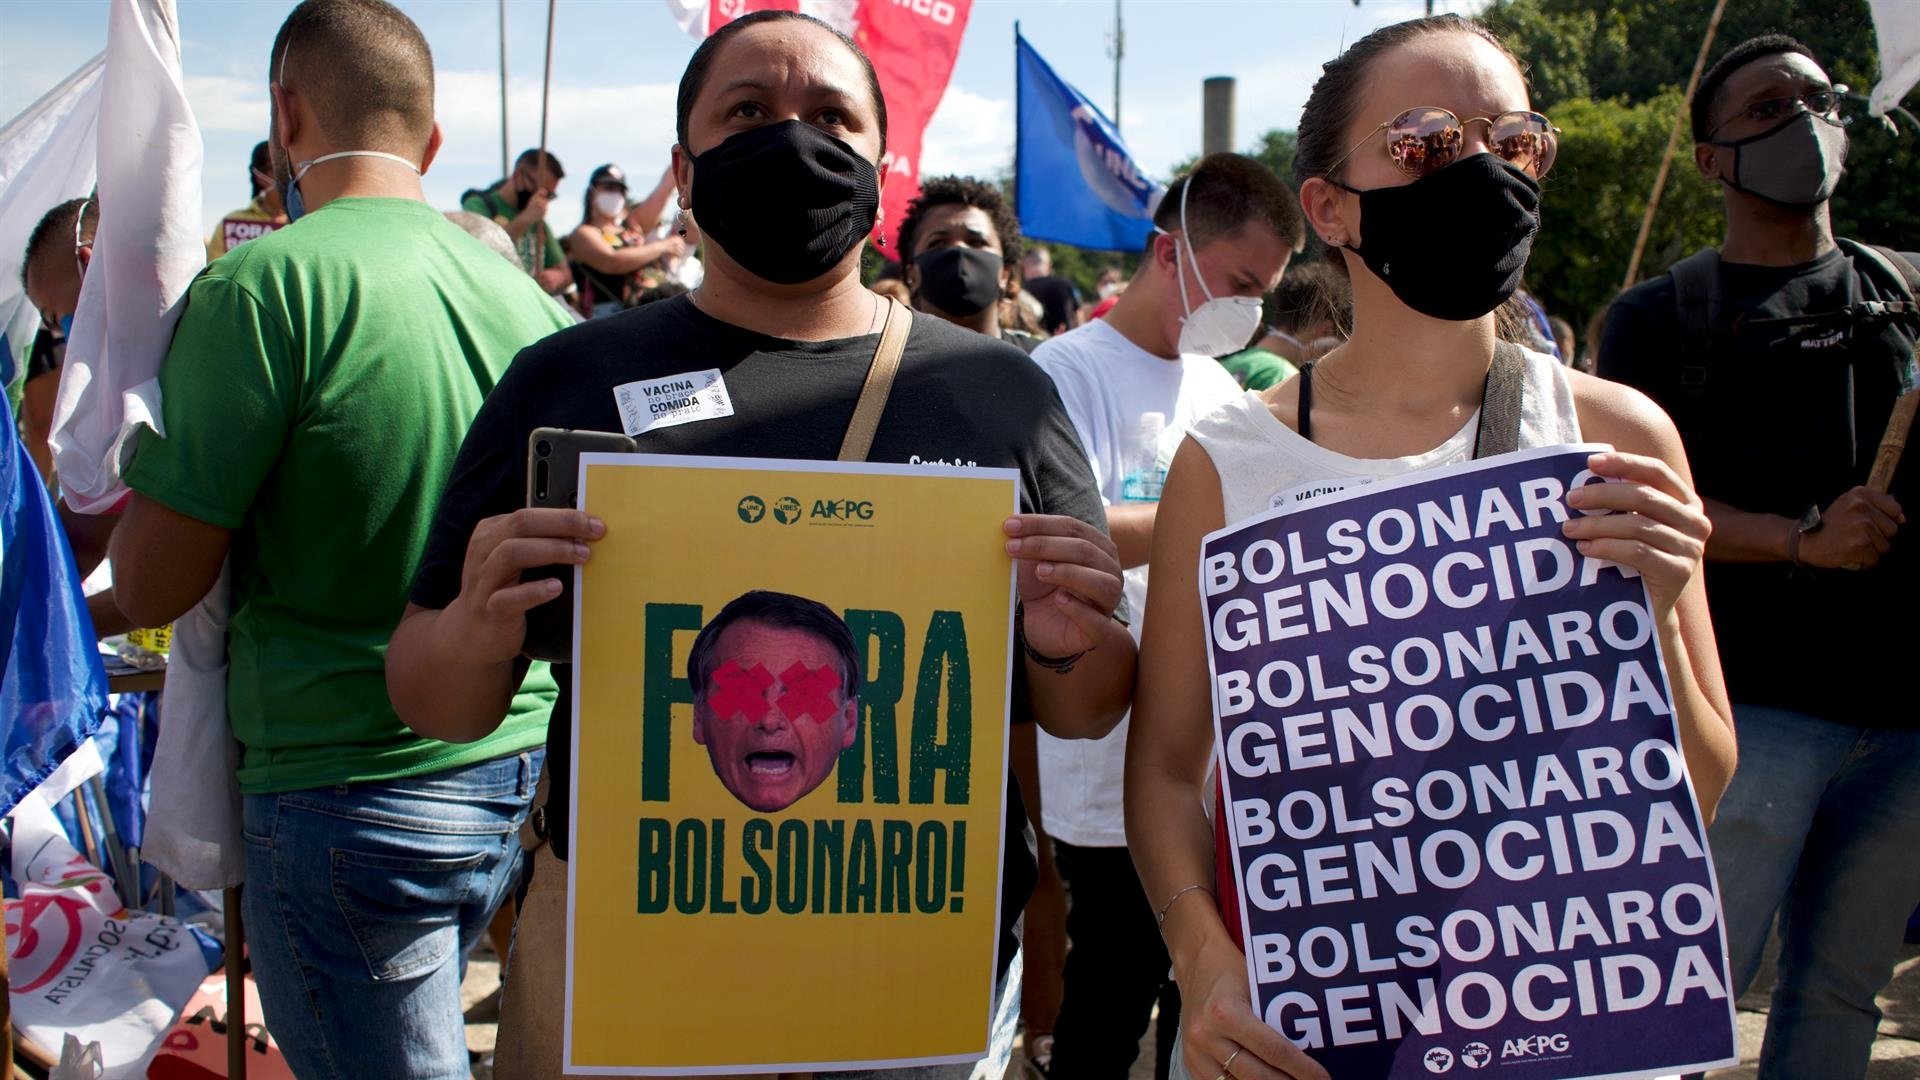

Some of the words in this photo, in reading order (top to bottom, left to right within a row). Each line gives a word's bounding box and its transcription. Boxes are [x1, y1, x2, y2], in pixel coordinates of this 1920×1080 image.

[643, 380, 694, 397] VACINA
[649, 396, 700, 414] COMIDA
[653, 412, 667, 420] no
[671, 406, 703, 419] prato
[1216, 601, 1651, 718] BOLSONARO
[1226, 660, 1670, 778] GENOCIDA
[1232, 739, 1685, 847] BOLSONARO
[637, 819, 967, 915] BOLSONARO!
[1246, 801, 1704, 912] GENOCIDA
[1251, 883, 1718, 984] BOLSONARO
[1264, 945, 1728, 1050] GENOCIDA
